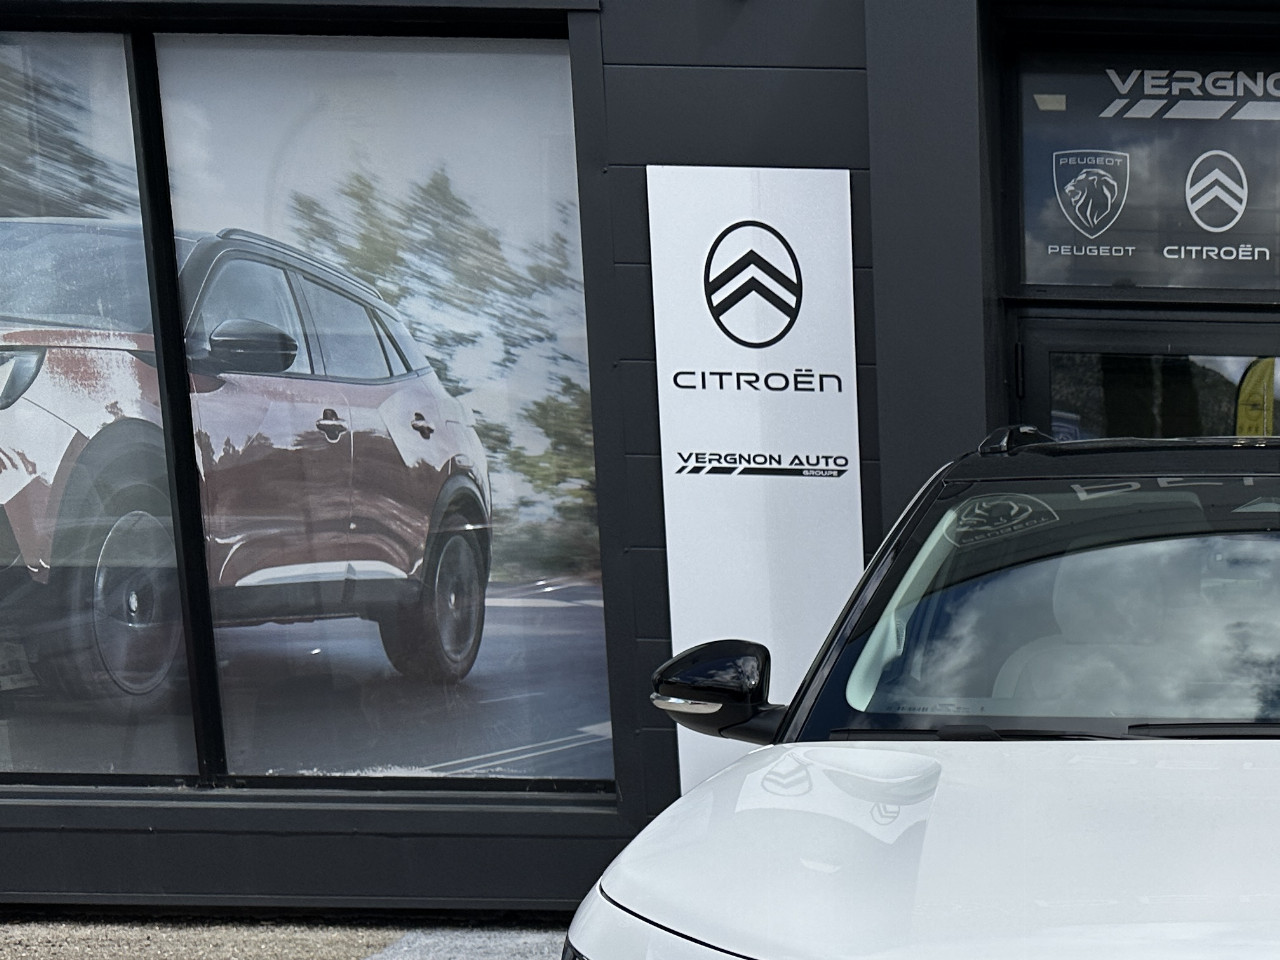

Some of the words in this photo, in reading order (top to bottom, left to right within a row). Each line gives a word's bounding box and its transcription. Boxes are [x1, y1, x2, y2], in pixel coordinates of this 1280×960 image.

[1059, 156, 1123, 167] PEUGEOT
[1048, 245, 1136, 257] PEUGEOT
[677, 452, 782, 466] VERGNON
[788, 454, 849, 468] AUTO
[802, 469, 839, 477] GROUPE
